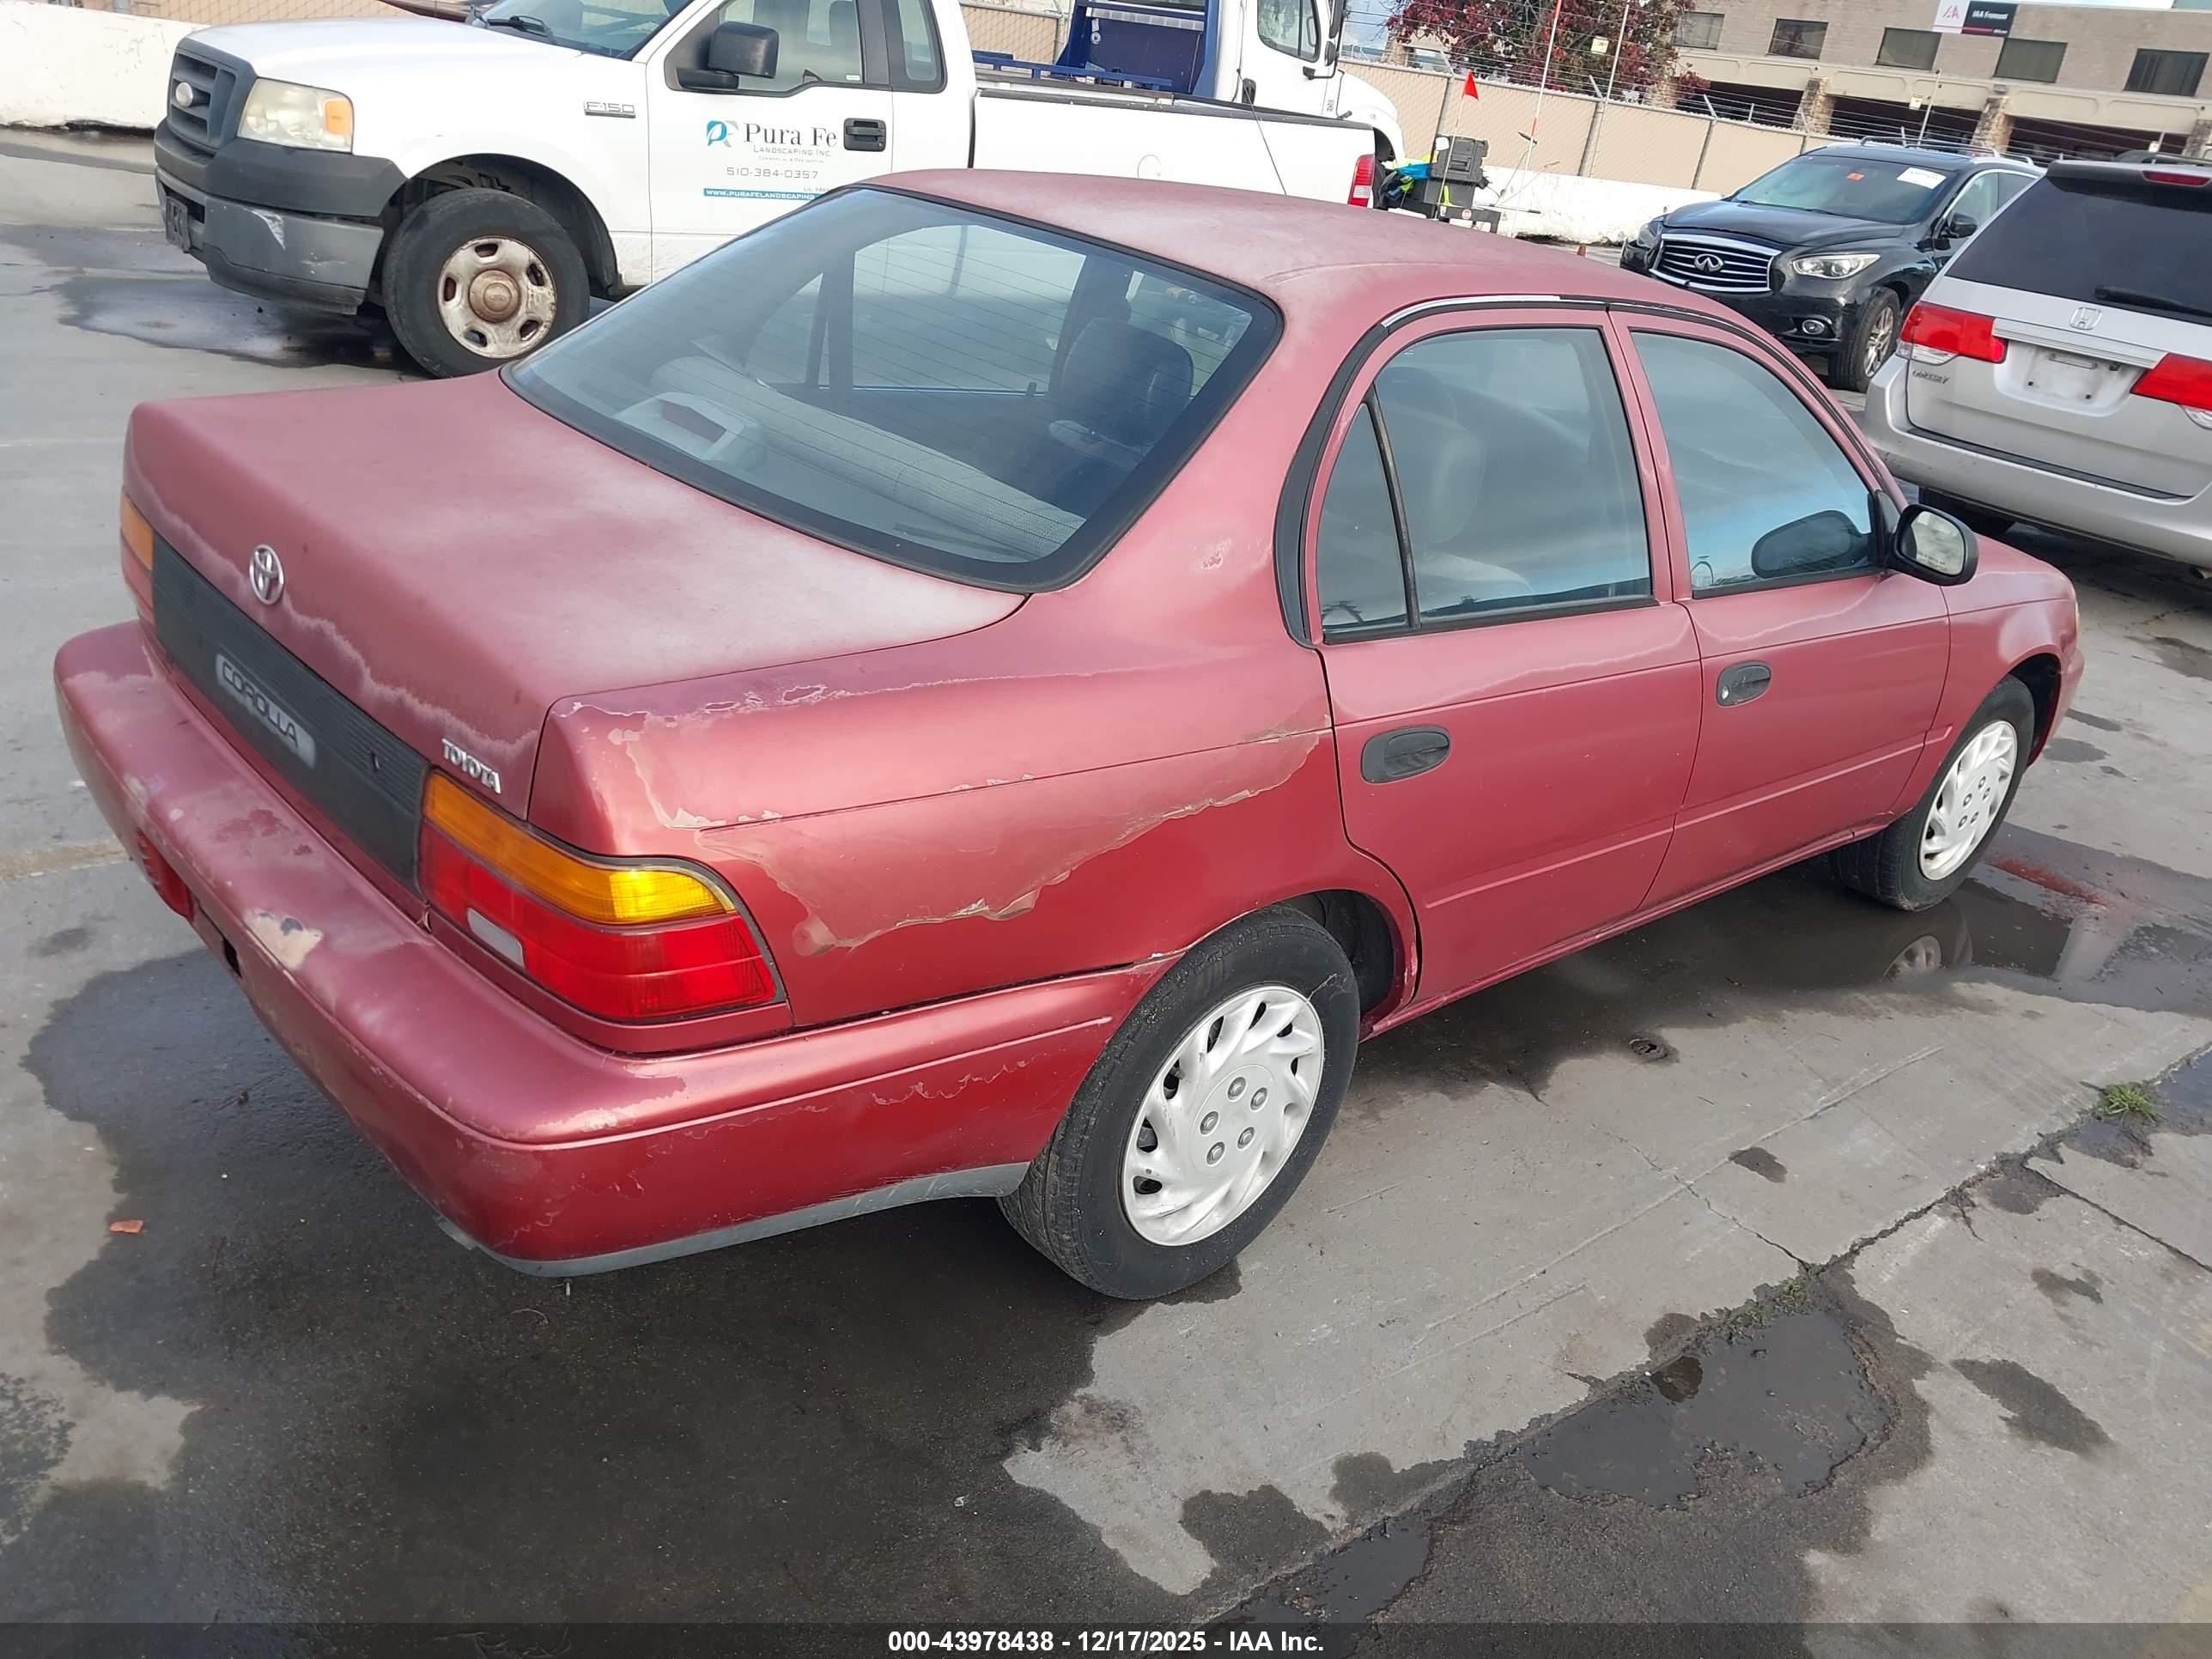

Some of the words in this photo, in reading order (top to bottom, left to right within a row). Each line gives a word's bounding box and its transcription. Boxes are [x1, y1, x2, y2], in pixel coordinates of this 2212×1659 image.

[743, 122, 802, 146] Pura
[810, 126, 837, 148] Fe
[726, 167, 818, 179] 510-384-0357
[222, 661, 299, 749] COROLLA
[441, 738, 502, 795] TOYOTA
